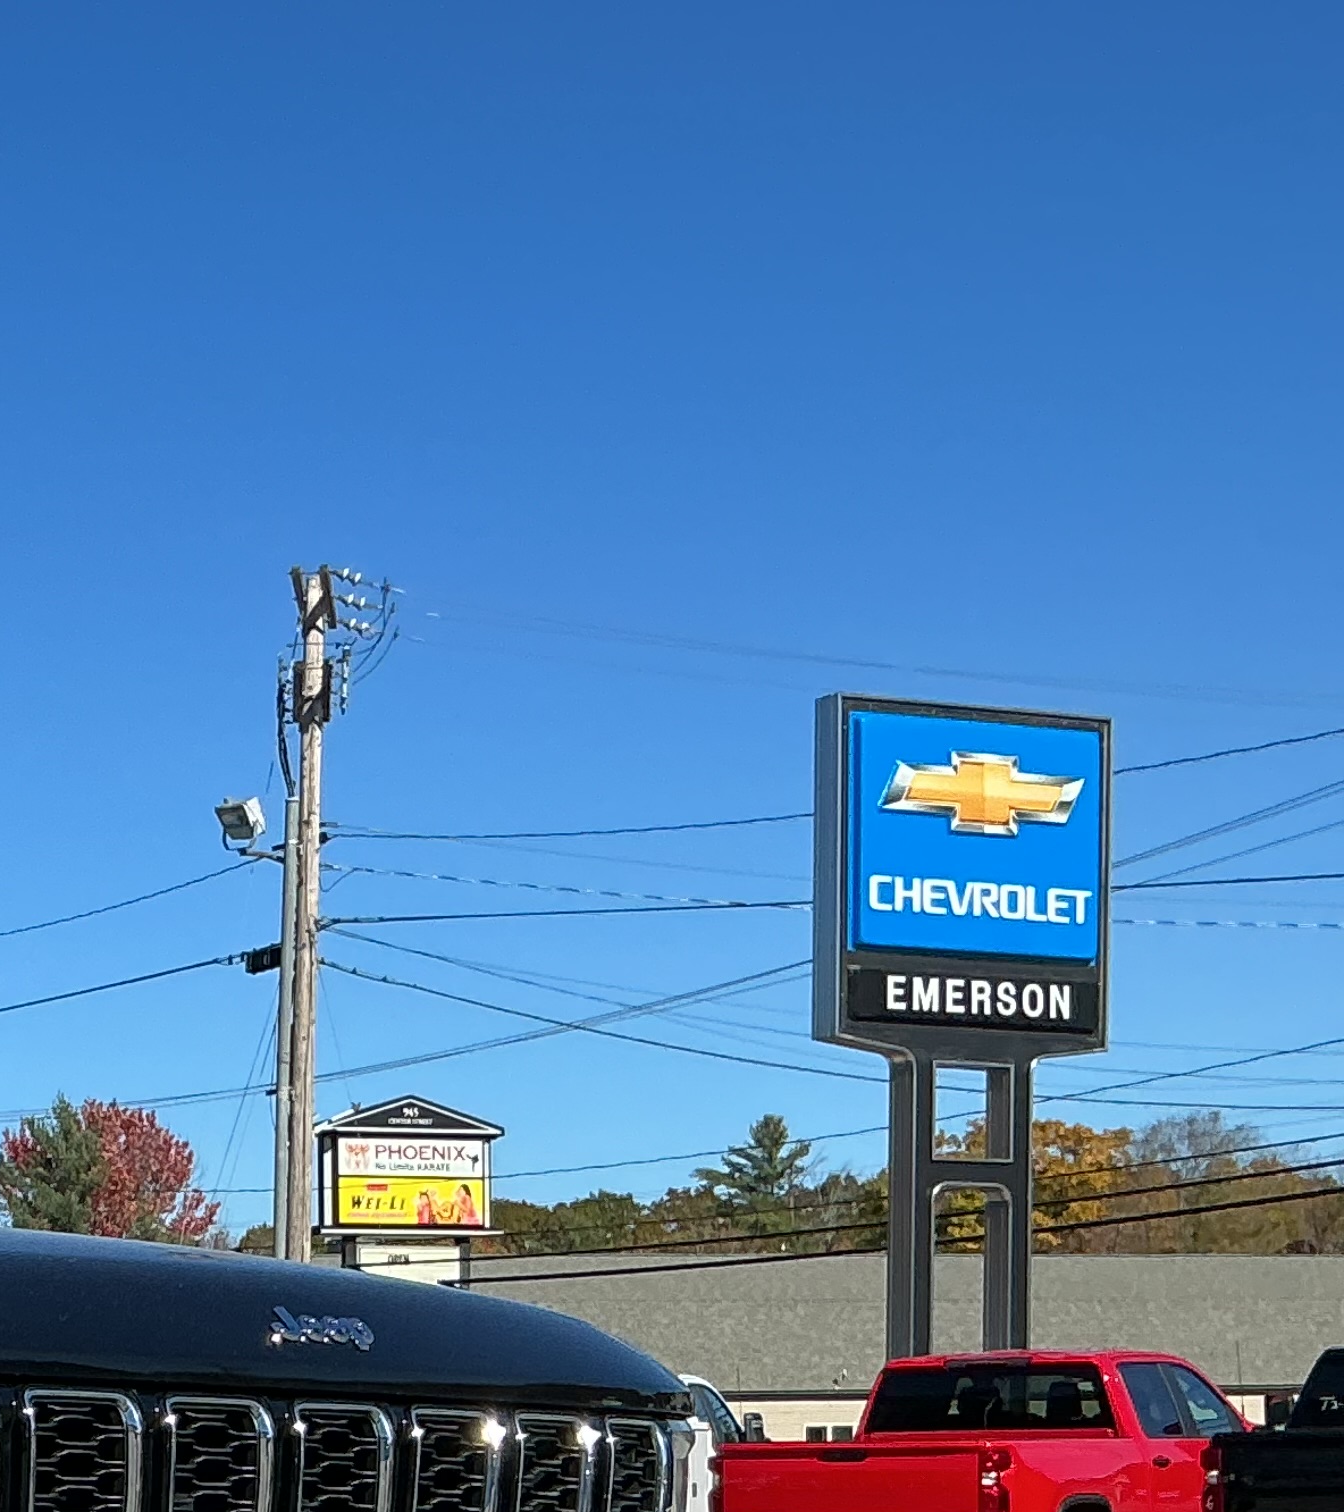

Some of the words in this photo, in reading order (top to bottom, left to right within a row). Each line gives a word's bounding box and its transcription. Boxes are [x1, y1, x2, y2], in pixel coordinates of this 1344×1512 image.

[868, 875, 1093, 924] CHEVROLET
[886, 975, 1071, 1020] EMERSON
[374, 1144, 466, 1161] PHOENIX
[269, 1305, 375, 1352] Jeep
